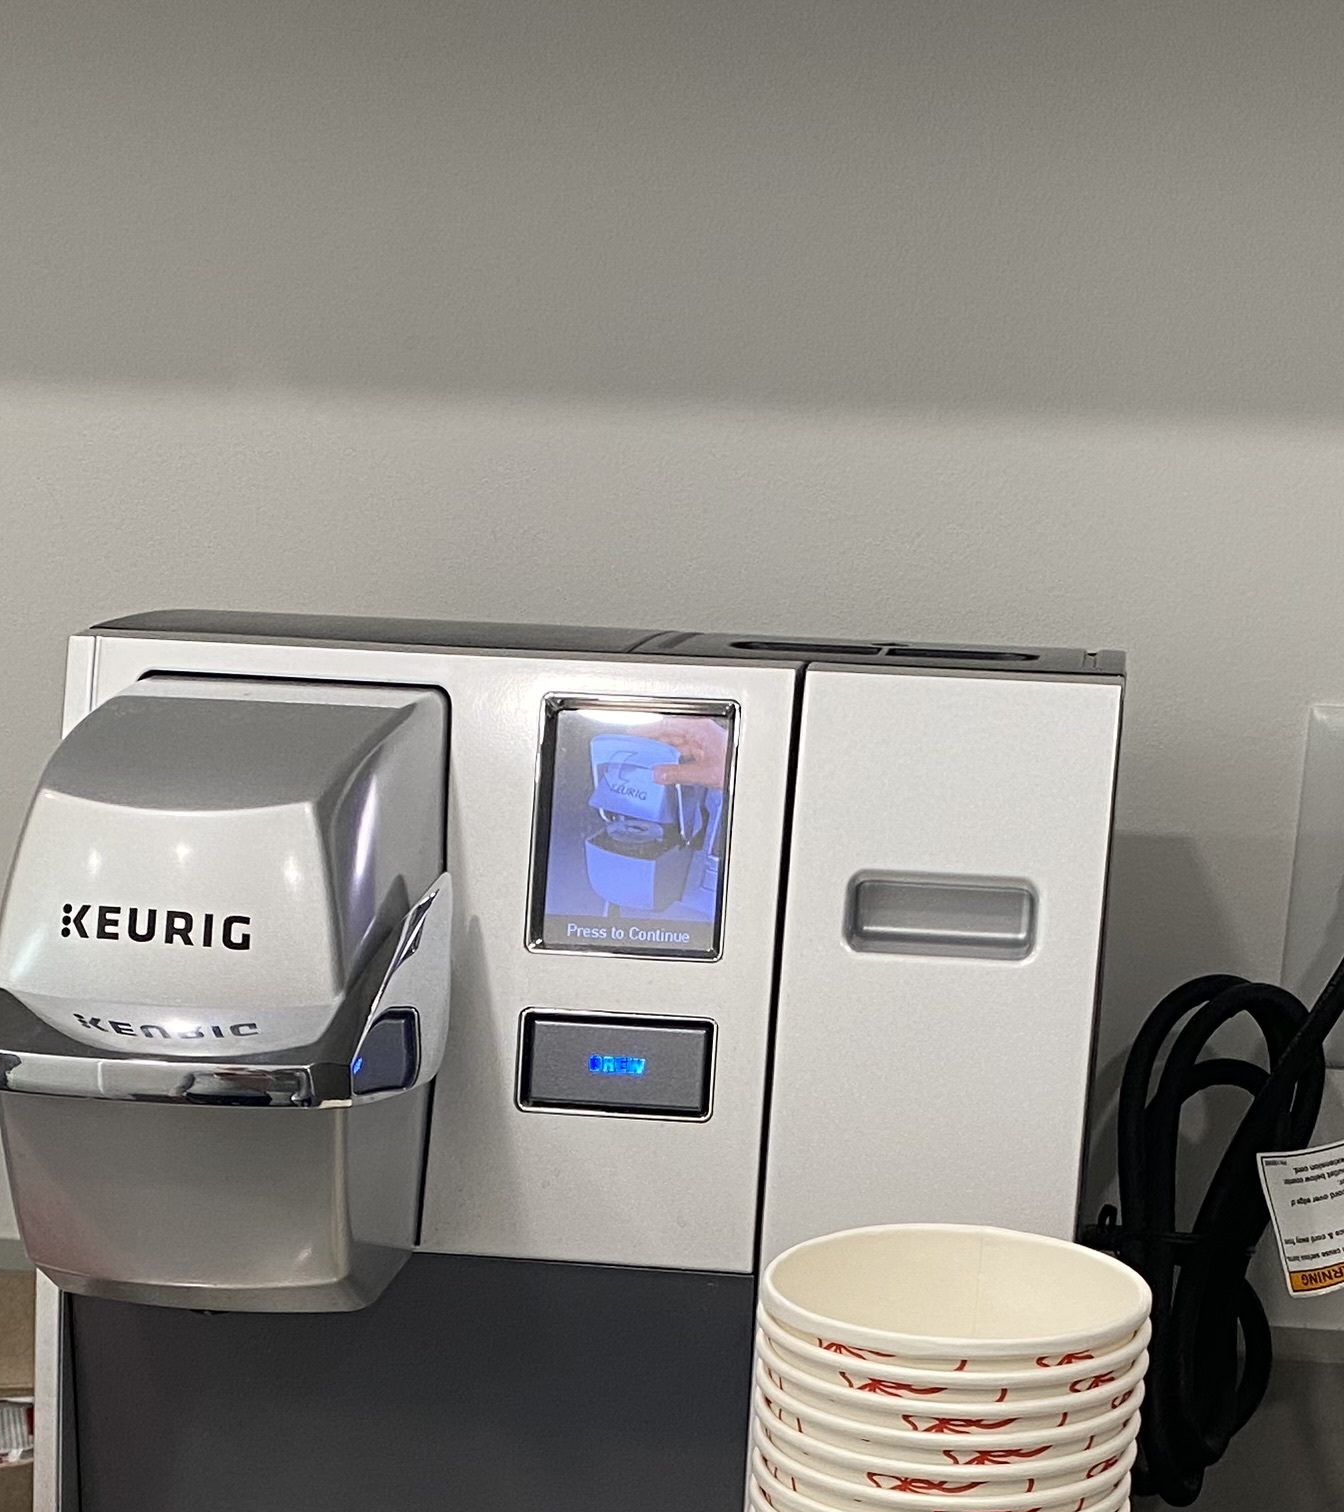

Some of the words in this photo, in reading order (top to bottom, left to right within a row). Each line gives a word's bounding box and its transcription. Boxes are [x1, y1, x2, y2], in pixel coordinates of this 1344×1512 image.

[61, 903, 251, 950] KEURIG
[567, 923, 607, 939] Press
[611, 928, 624, 940] to
[629, 927, 690, 943] Continue
[589, 1055, 645, 1074] BREW
[1310, 1156, 1344, 1170] extension
[1305, 1172, 1327, 1181] below
[1312, 1193, 1329, 1201] over
[1321, 1248, 1341, 1258] cause
